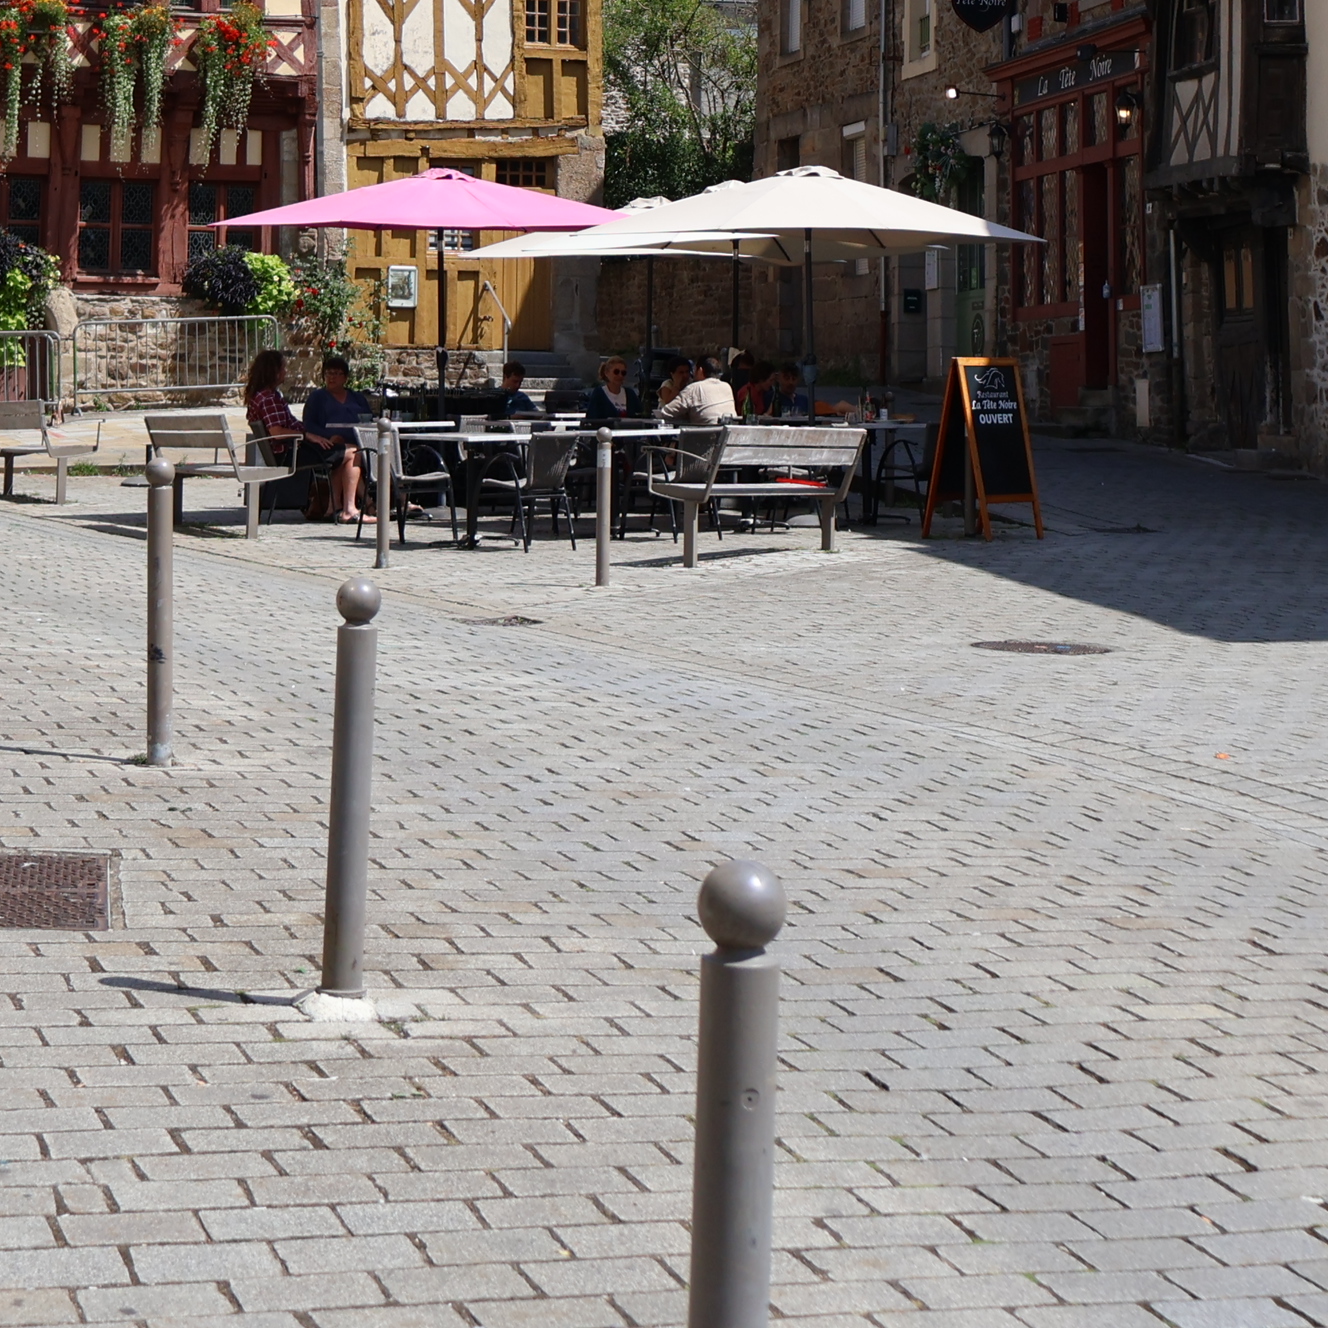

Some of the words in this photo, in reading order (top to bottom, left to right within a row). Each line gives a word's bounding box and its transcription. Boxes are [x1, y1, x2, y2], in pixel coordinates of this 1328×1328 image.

[1037, 76, 1048, 96] La
[1059, 66, 1076, 89] Tête
[1089, 54, 1112, 81] Noire
[971, 400, 981, 410] La
[982, 399, 997, 410] Tête
[998, 399, 1017, 410] Noire
[979, 413, 1013, 425] OUVERT
